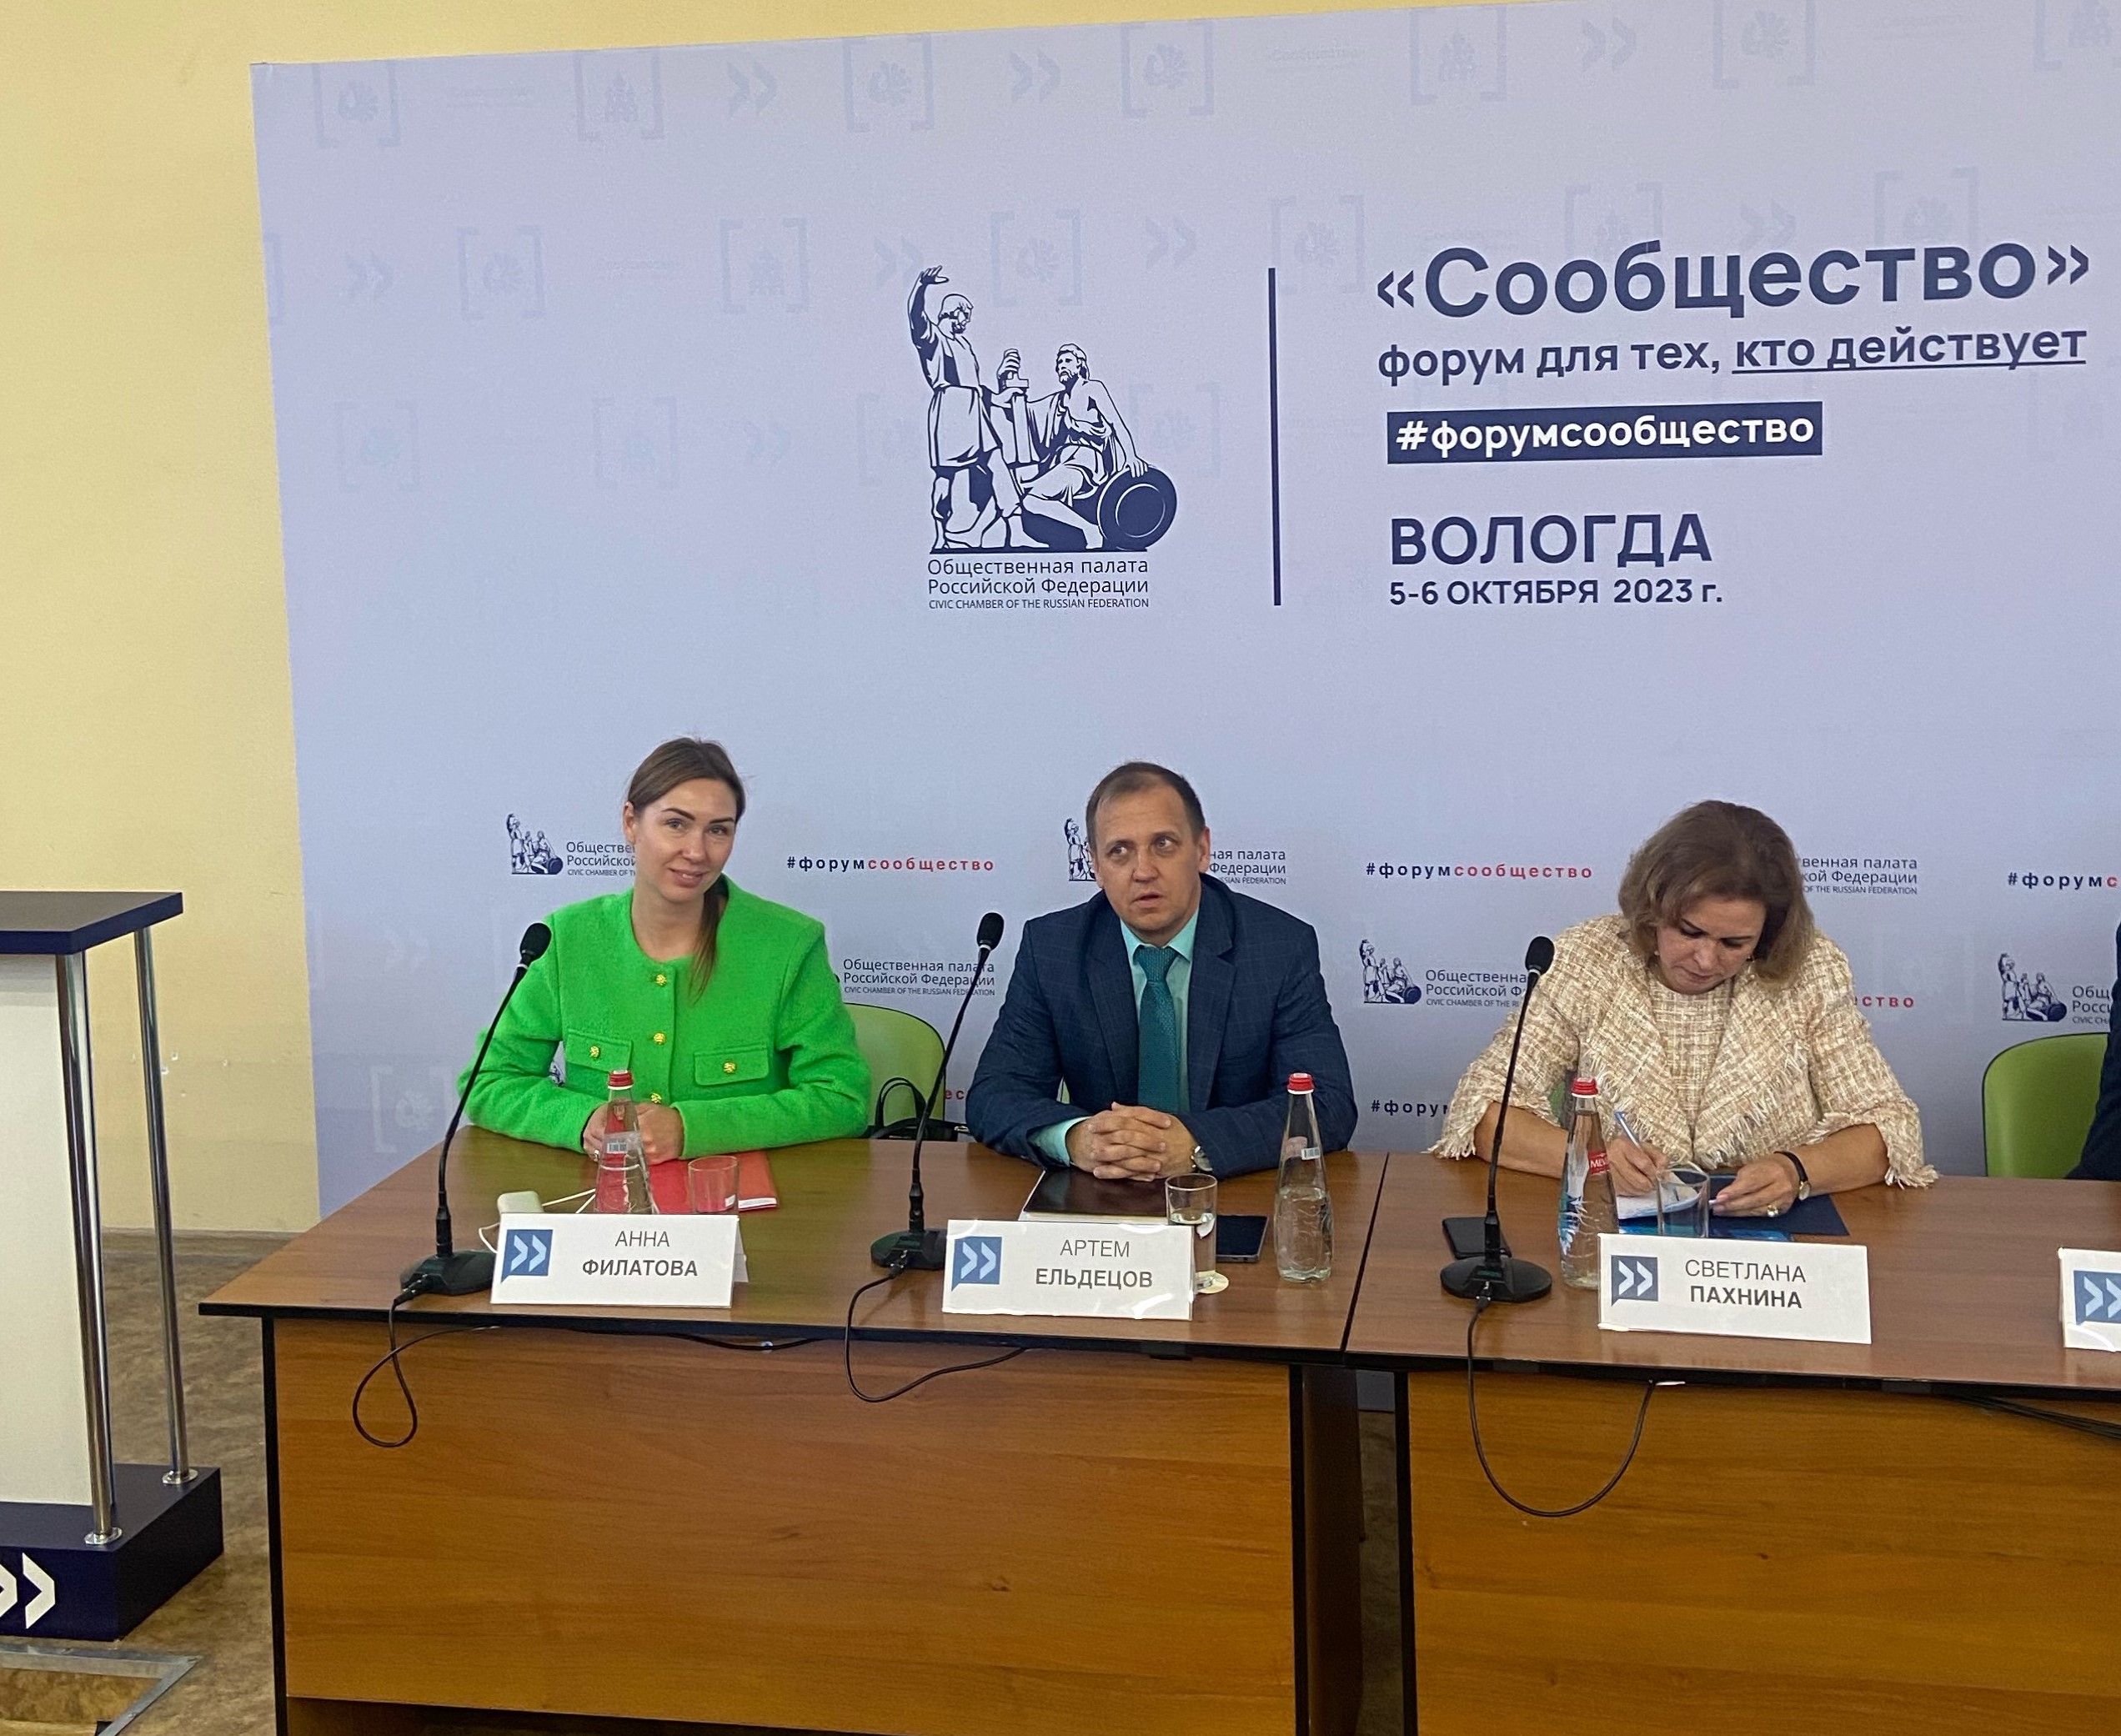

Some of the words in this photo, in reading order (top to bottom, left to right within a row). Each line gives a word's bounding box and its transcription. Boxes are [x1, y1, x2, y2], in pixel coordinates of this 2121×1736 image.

[1377, 239, 2089, 319] «Сообщество»
[1378, 344, 1524, 388] форум
[1536, 344, 1618, 379] для
[1630, 342, 1720, 374] тех,
[1734, 334, 1815, 365] кто
[1827, 325, 2087, 372] действует
[1396, 414, 1814, 458] #форумсообщество
[1391, 513, 1712, 569] ВОЛОГДА
[927, 558, 1074, 579] Общественная
[1081, 560, 1148, 574] палата
[928, 577, 1035, 595] Российской
[1041, 578, 1148, 598] Федерации
[1390, 580, 1439, 605] 5-6
[1447, 580, 1599, 605] ОКТЯБРЯ
[1613, 578, 1692, 604] 2023
[1702, 584, 1722, 603] г.
[929, 600, 954, 610] CIVIC
[955, 599, 1005, 610] CHAMBER
[1005, 599, 1020, 609] OF
[1021, 599, 1041, 609] THE
[1043, 599, 1085, 609] RUSSIAN
[1087, 598, 1149, 609] FEDERATION
[786, 855, 994, 873] #форумсообщество
[1237, 850, 1286, 860] палата
[1804, 857, 1858, 868] венная
[1863, 858, 1918, 869] палата
[1210, 862, 1286, 876] Федерации
[1366, 862, 1592, 880] #форумсообщество
[1832, 870, 1918, 886] Федерации
[1868, 886, 1918, 895] FEDERATION
[844, 959, 944, 972] Общественная
[844, 972, 917, 984] Российской
[1426, 970, 1527, 984] Общественна
[1426, 984, 1507, 996] Российской
[1853, 996, 1913, 1008] ство
[614, 1230, 670, 1247] АННА
[1060, 1239, 1130, 1258] АРТЕМ
[582, 1259, 698, 1277] ФИЛАТОВА
[1685, 1259, 1807, 1283] СВЕТЛАНА
[1035, 1267, 1153, 1291] ЕЛЬДЕЦОВ
[1690, 1285, 1803, 1309] ПАХНИНА
